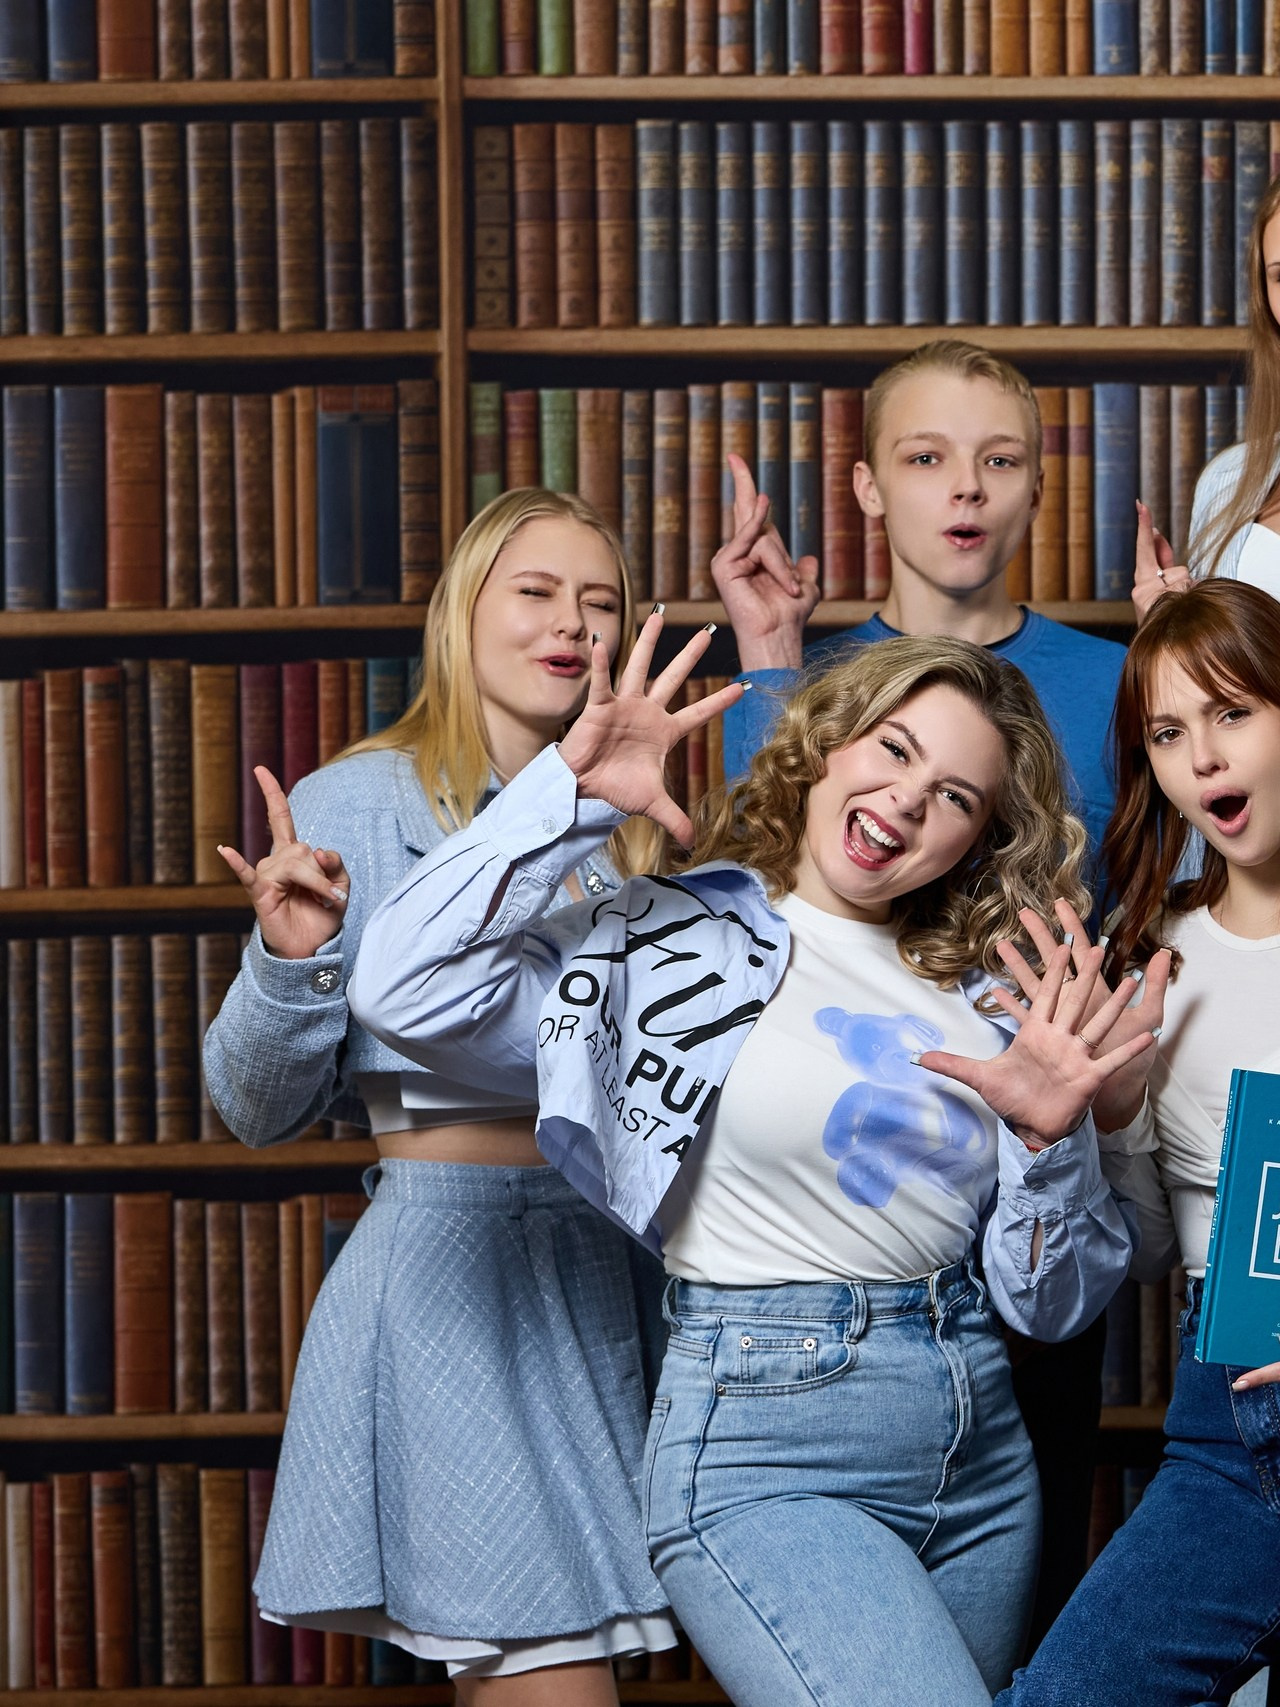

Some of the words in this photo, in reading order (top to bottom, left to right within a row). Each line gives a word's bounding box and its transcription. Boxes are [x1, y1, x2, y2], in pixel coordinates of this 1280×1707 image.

[537, 1014, 581, 1048] OR
[584, 1029, 608, 1064] AT
[601, 1062, 671, 1141] LEAST
